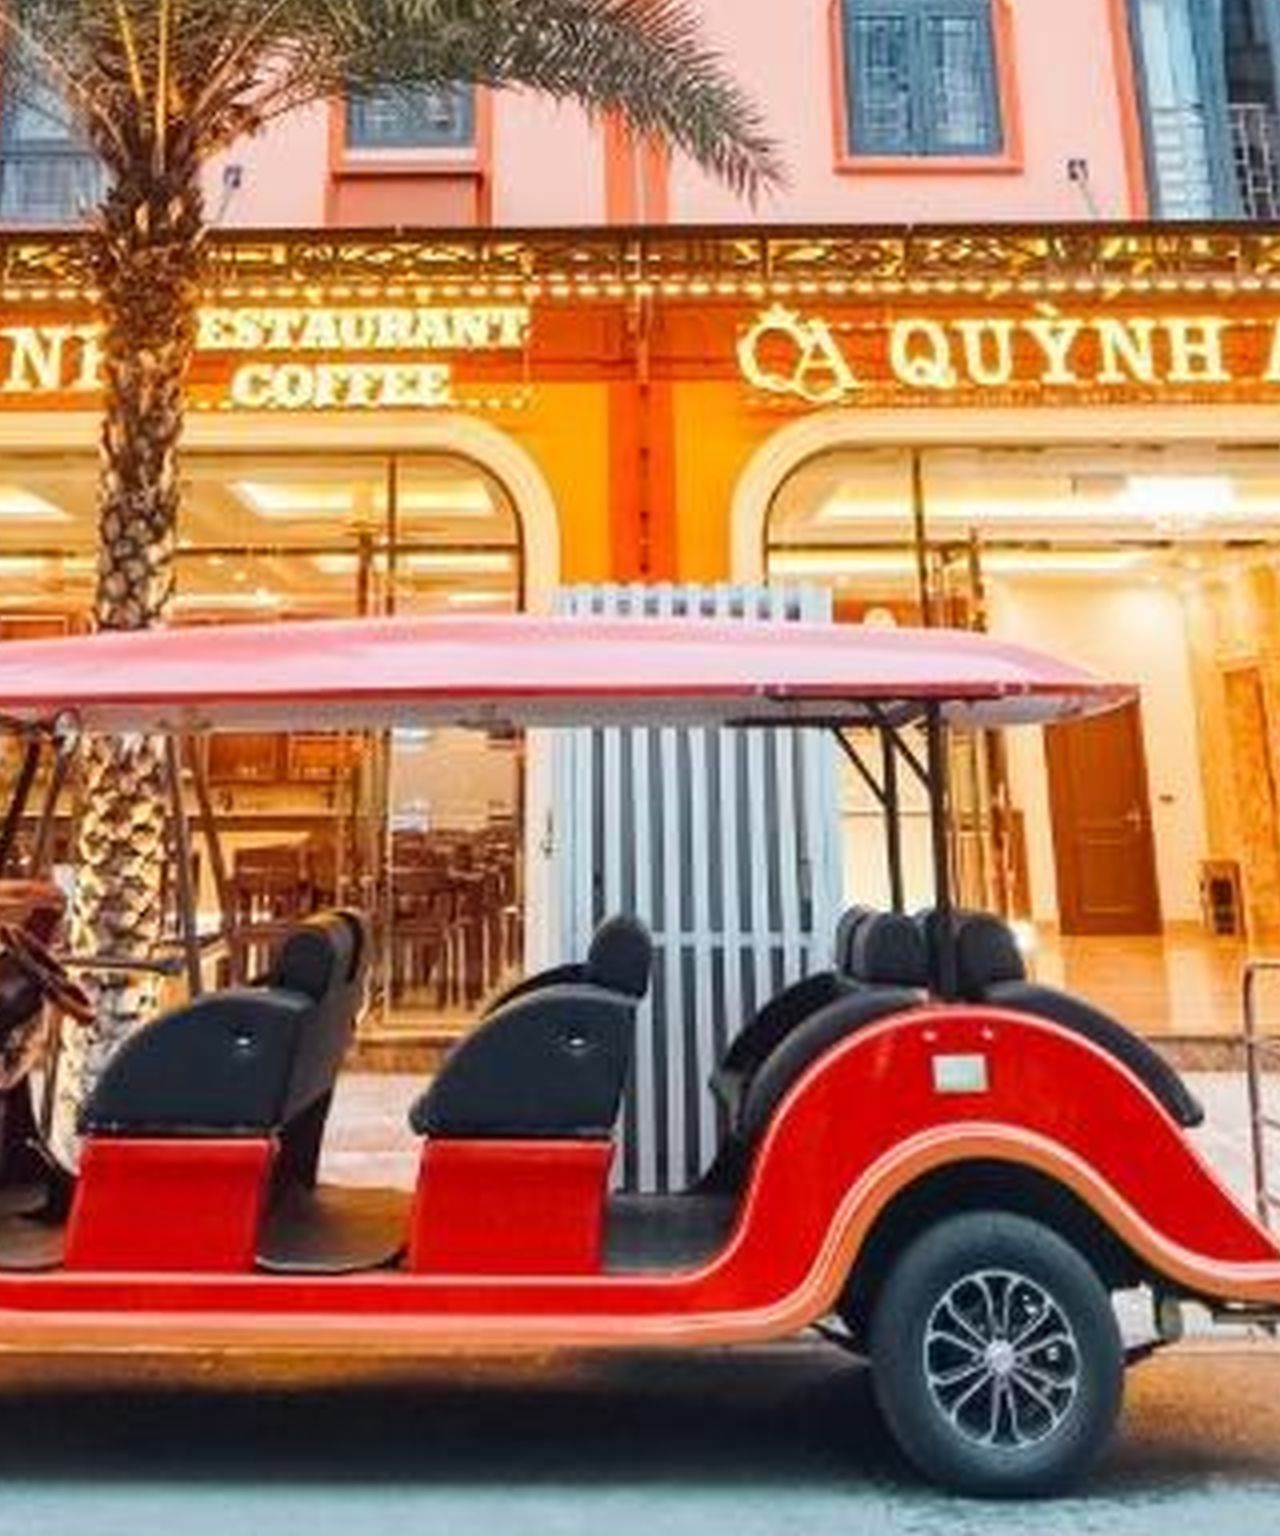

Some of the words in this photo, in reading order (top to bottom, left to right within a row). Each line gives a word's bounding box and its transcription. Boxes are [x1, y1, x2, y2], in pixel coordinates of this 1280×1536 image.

[196, 307, 526, 350] ESTAURANT
[890, 302, 1231, 387] QUỲNH
[231, 363, 451, 406] COFFEE
